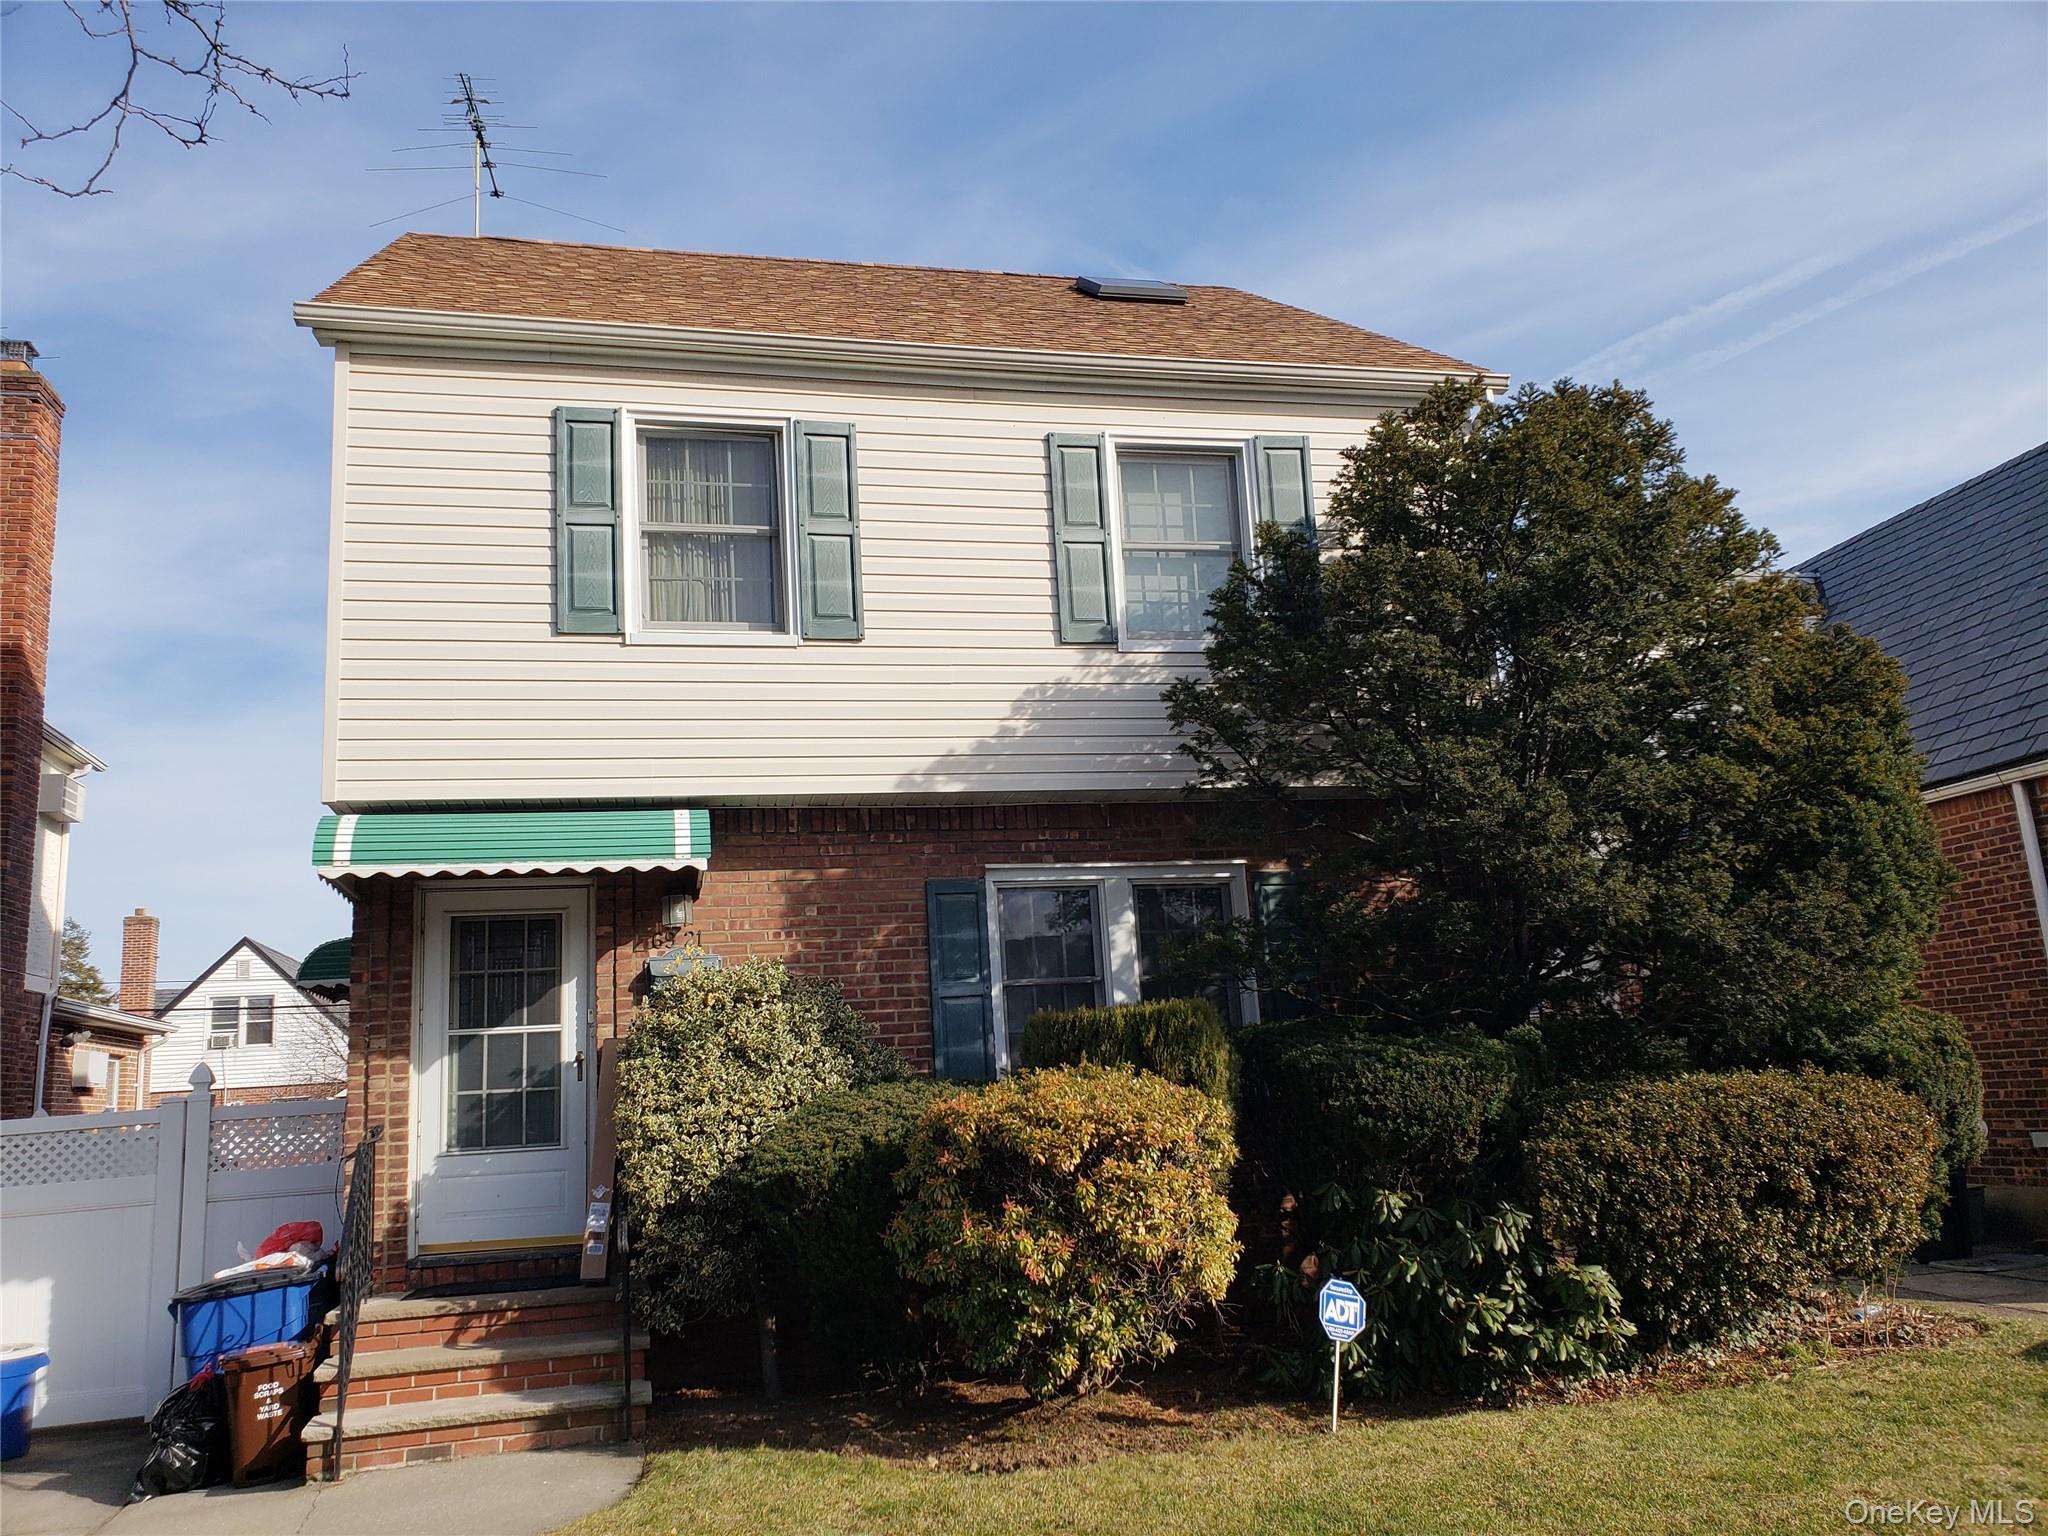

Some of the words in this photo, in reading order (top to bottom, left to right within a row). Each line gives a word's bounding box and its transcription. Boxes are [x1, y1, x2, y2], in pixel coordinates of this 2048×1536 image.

[1325, 1298, 1359, 1325] ADT
[257, 1381, 280, 1391] FOOD
[253, 1387, 284, 1399] SCRAPS
[256, 1408, 283, 1420] WASTE
[259, 1403, 280, 1413] YARD
